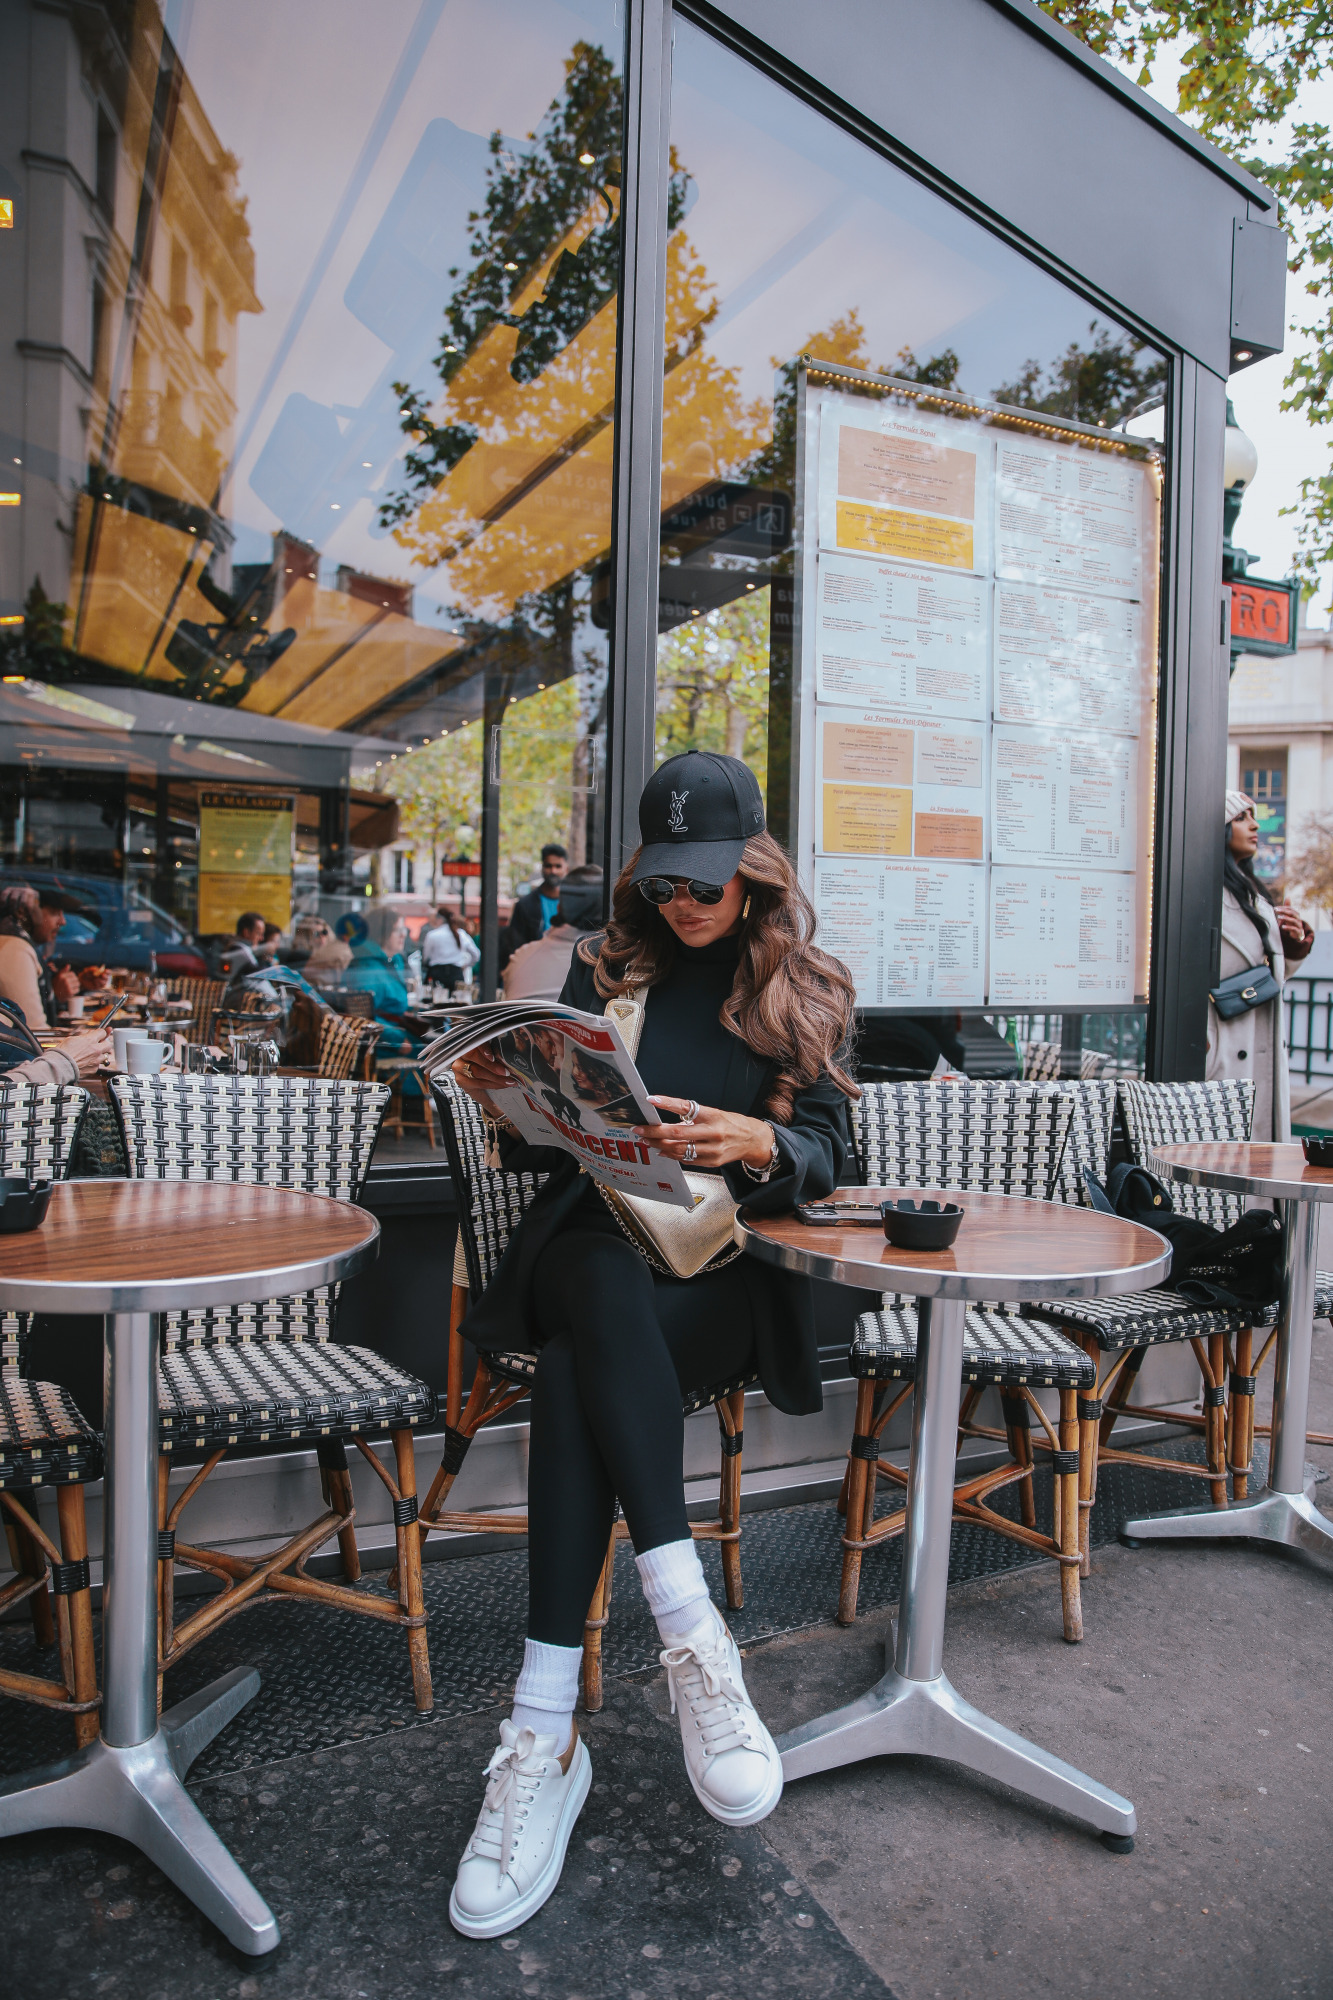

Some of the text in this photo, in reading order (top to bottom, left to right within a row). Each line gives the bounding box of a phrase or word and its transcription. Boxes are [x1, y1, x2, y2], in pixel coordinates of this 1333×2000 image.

[1230, 591, 1281, 634] RO
[863, 714, 873, 722] Les
[873, 715, 901, 724] Formules
